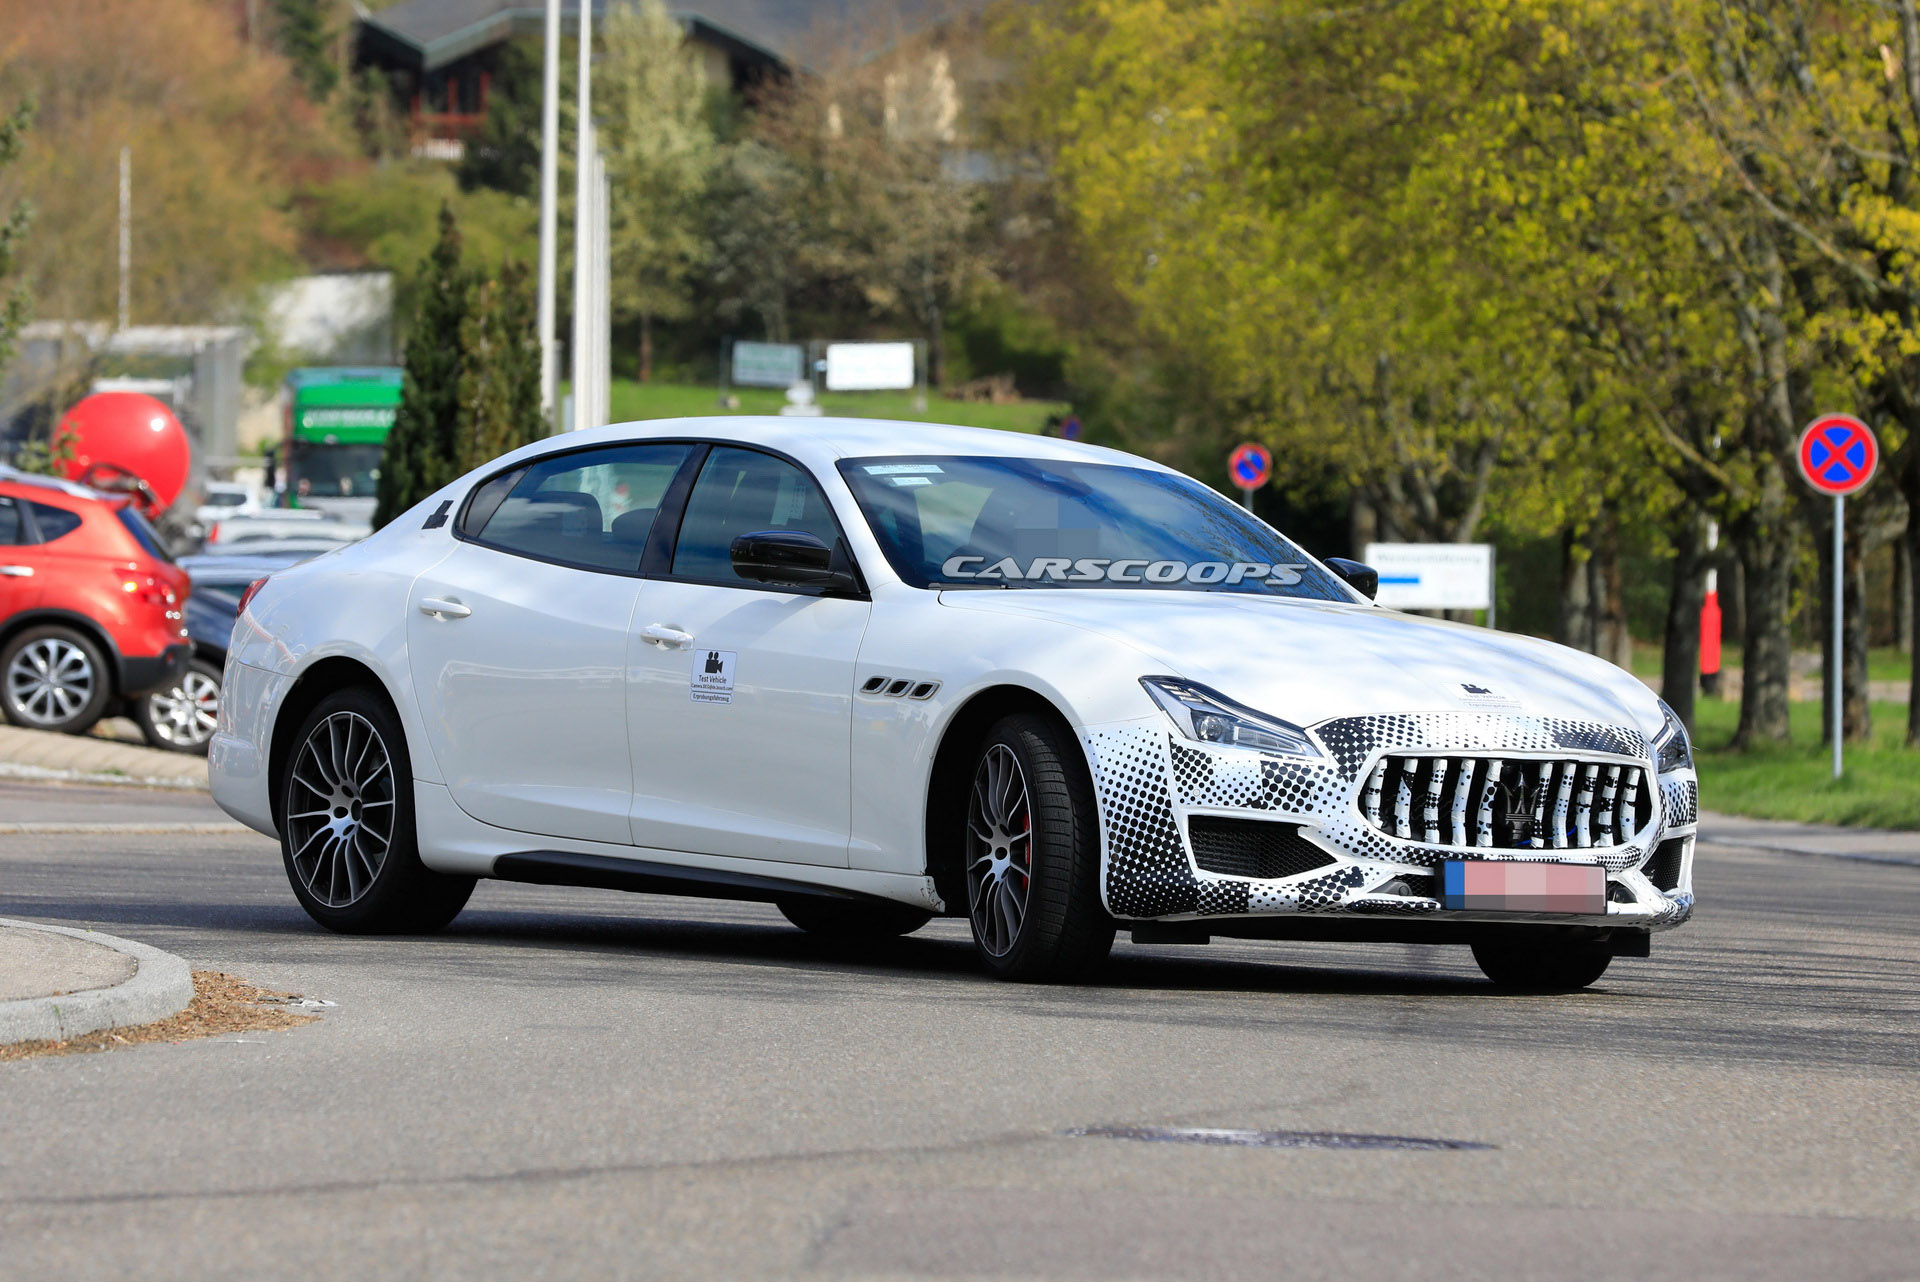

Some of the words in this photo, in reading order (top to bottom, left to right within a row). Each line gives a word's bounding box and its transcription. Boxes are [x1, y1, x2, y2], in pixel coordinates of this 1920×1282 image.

[698, 674, 709, 683] Test
[709, 675, 727, 684] Vehicle
[692, 693, 730, 702] Erprobungsfahrzeug
